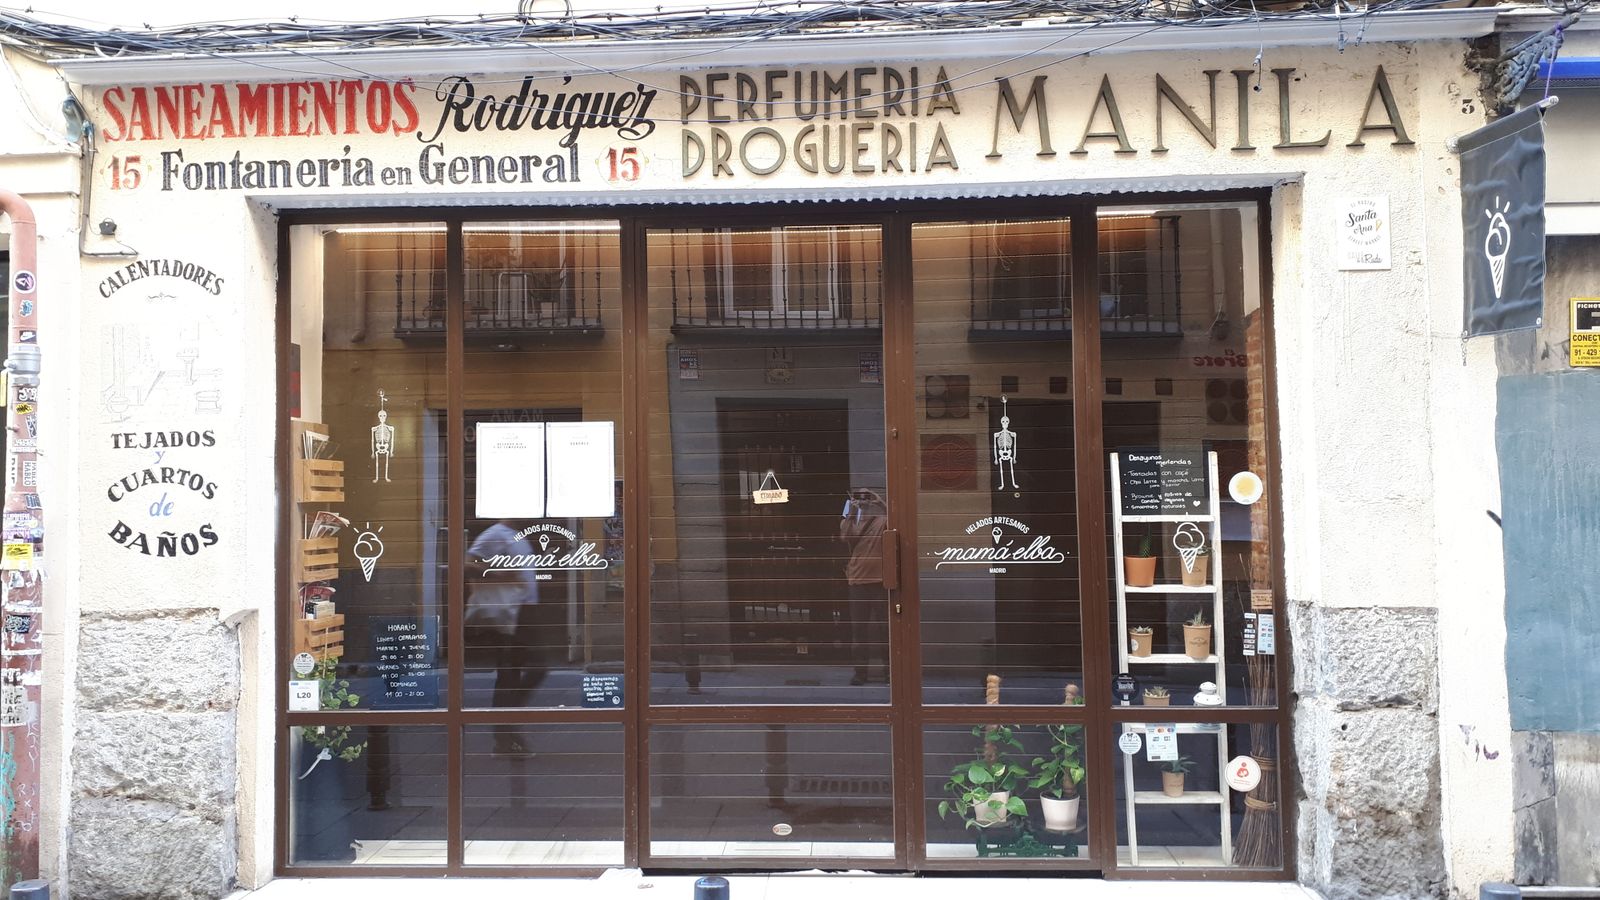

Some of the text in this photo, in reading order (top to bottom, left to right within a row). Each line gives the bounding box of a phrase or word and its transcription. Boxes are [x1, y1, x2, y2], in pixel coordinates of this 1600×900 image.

[102, 75, 658, 149] SANEAMIENTOS Rodríguez
[679, 64, 1416, 158] PERFUMERIA MANILA
[607, 147, 641, 182] 15
[681, 121, 959, 178] DROGUERIA
[108, 155, 141, 190] 15
[161, 143, 581, 191] Fontanería en General
[1345, 209, 1377, 228] Santa
[1354, 224, 1373, 235] Ana
[99, 258, 225, 299] CALENTADORES
[111, 429, 216, 450] TEJADOS
[154, 450, 166, 464] y
[107, 466, 219, 503] CUARTOS
[150, 492, 174, 517] de
[107, 520, 219, 558] BAÑOS
[513, 524, 577, 542] HELADOS ARTESANOS
[965, 516, 1030, 534] HELADOS ARTESANOS
[482, 542, 608, 569] mamá elba
[934, 535, 1065, 563] mamá elba
